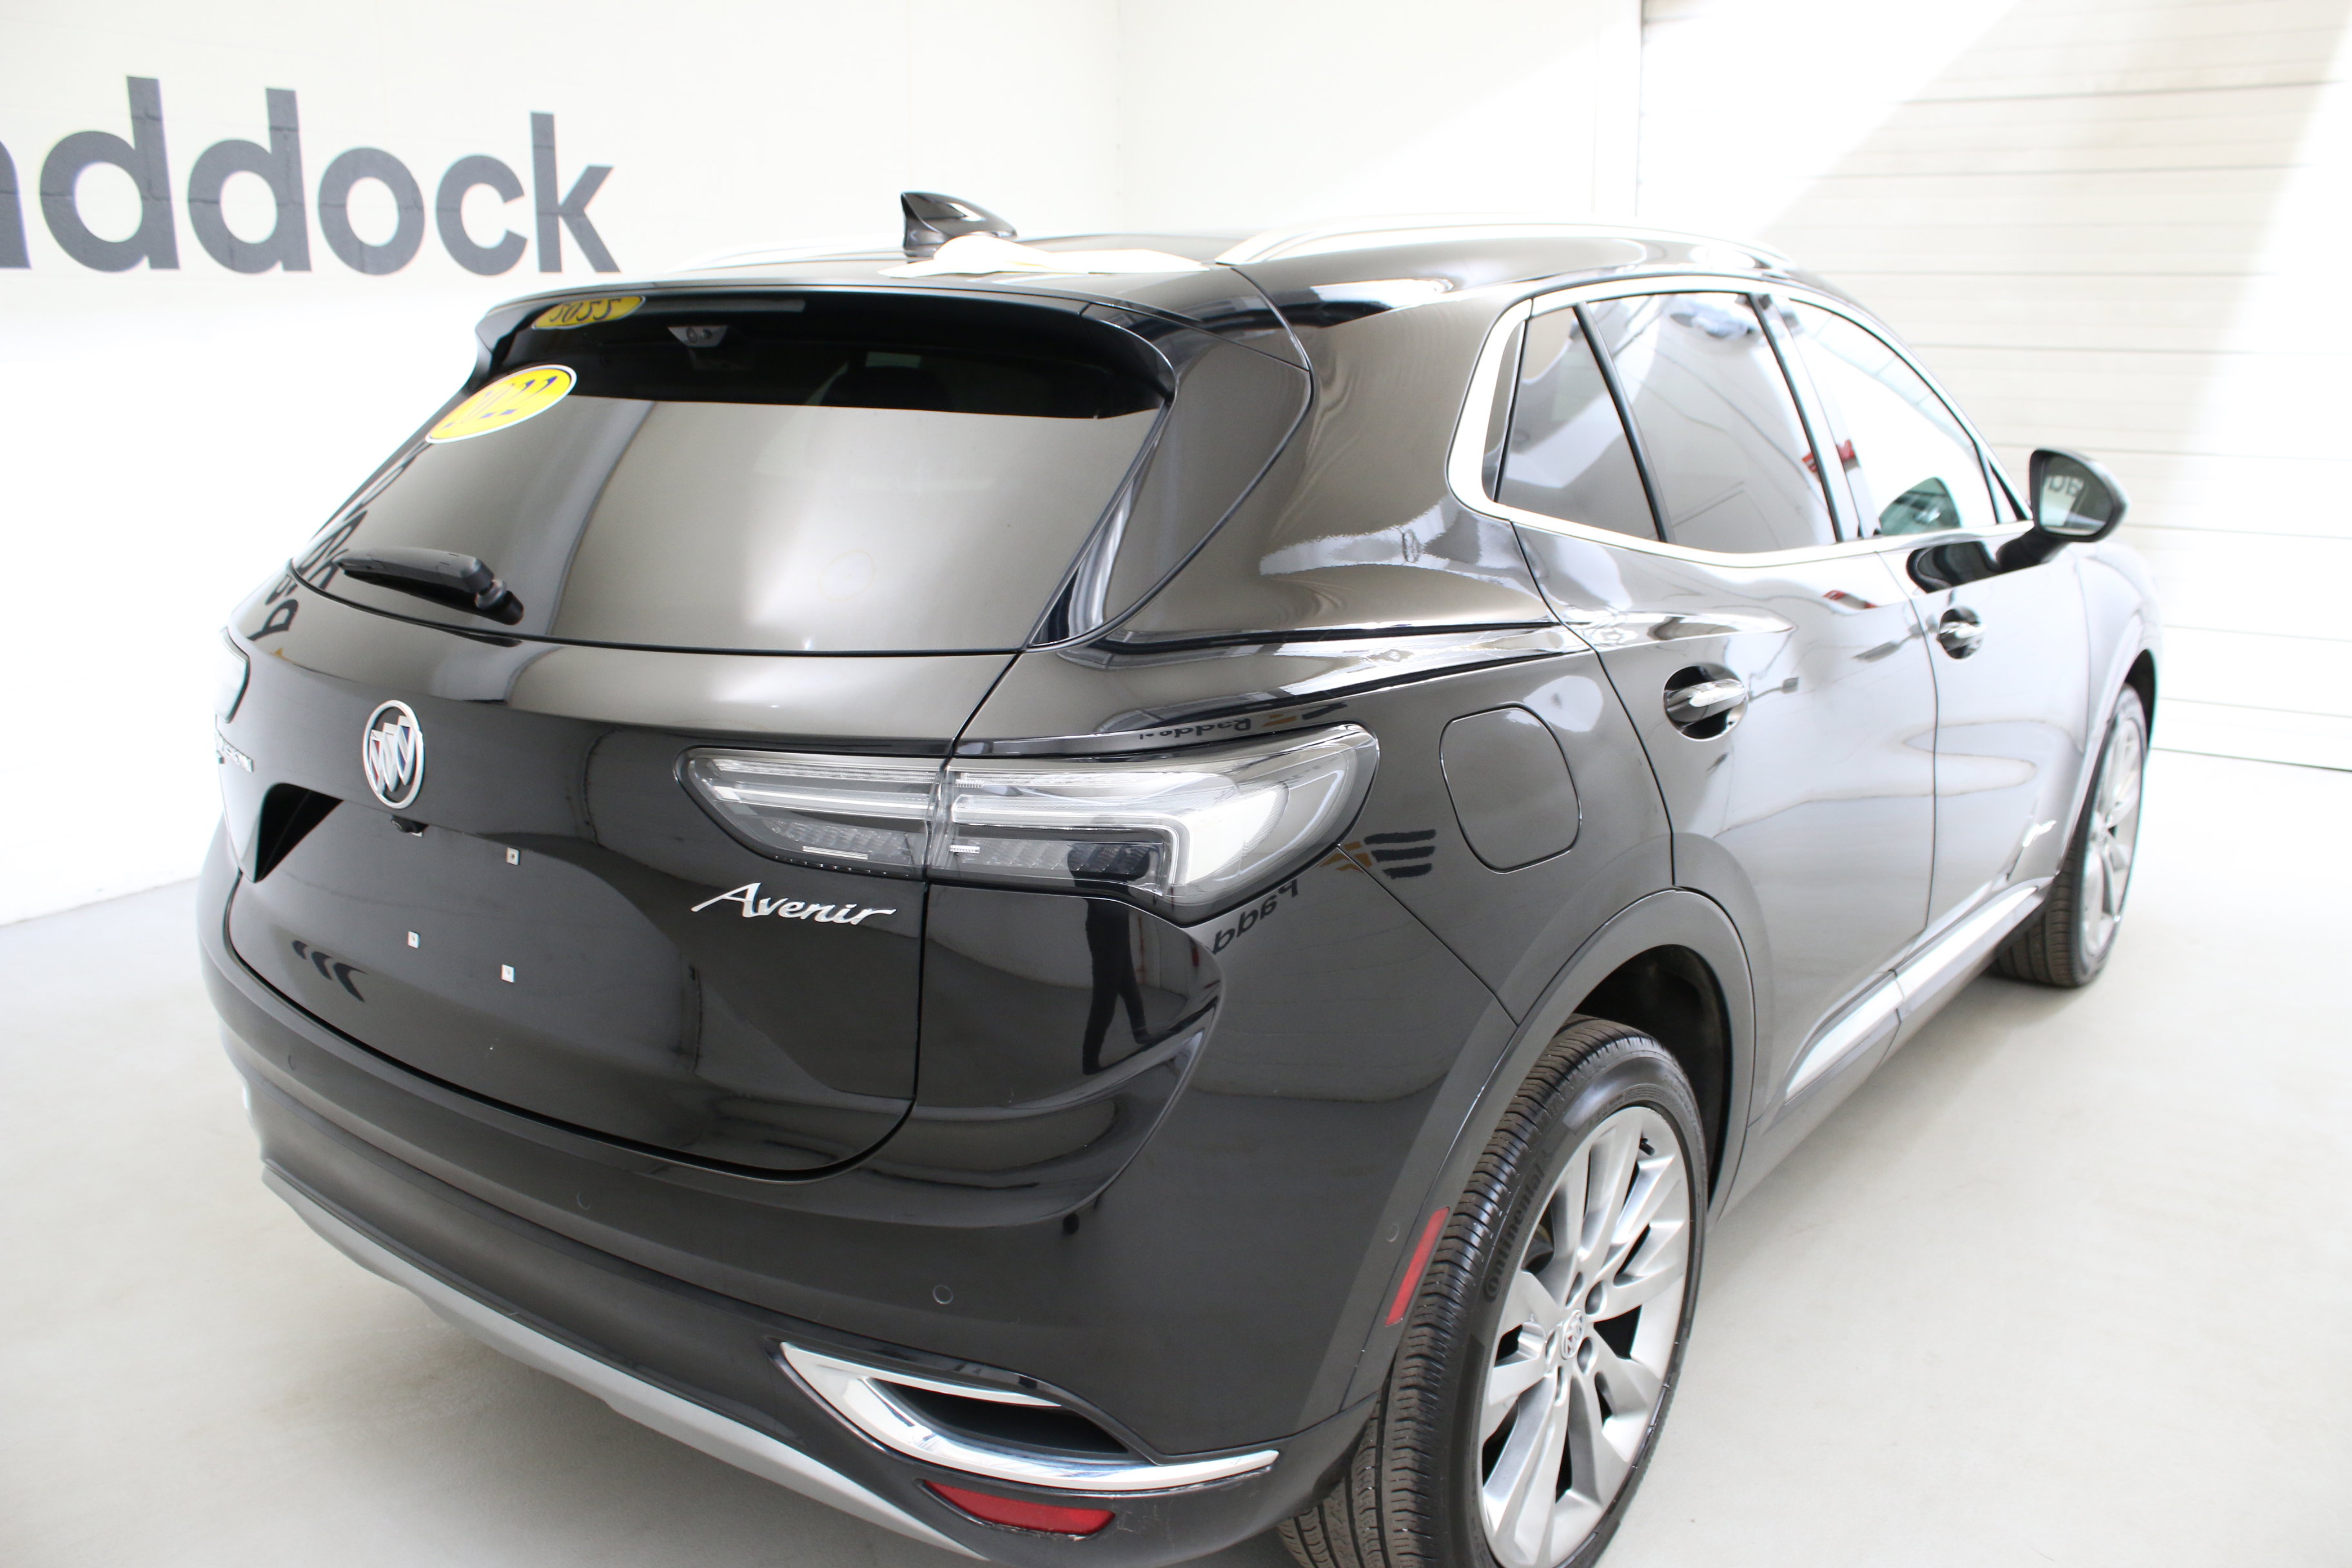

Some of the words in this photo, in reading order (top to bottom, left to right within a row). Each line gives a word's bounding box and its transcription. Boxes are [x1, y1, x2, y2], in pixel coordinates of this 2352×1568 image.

[0, 75, 621, 276] ddock
[691, 882, 897, 925] Avenir
[1484, 1162, 1545, 1303] Continental
